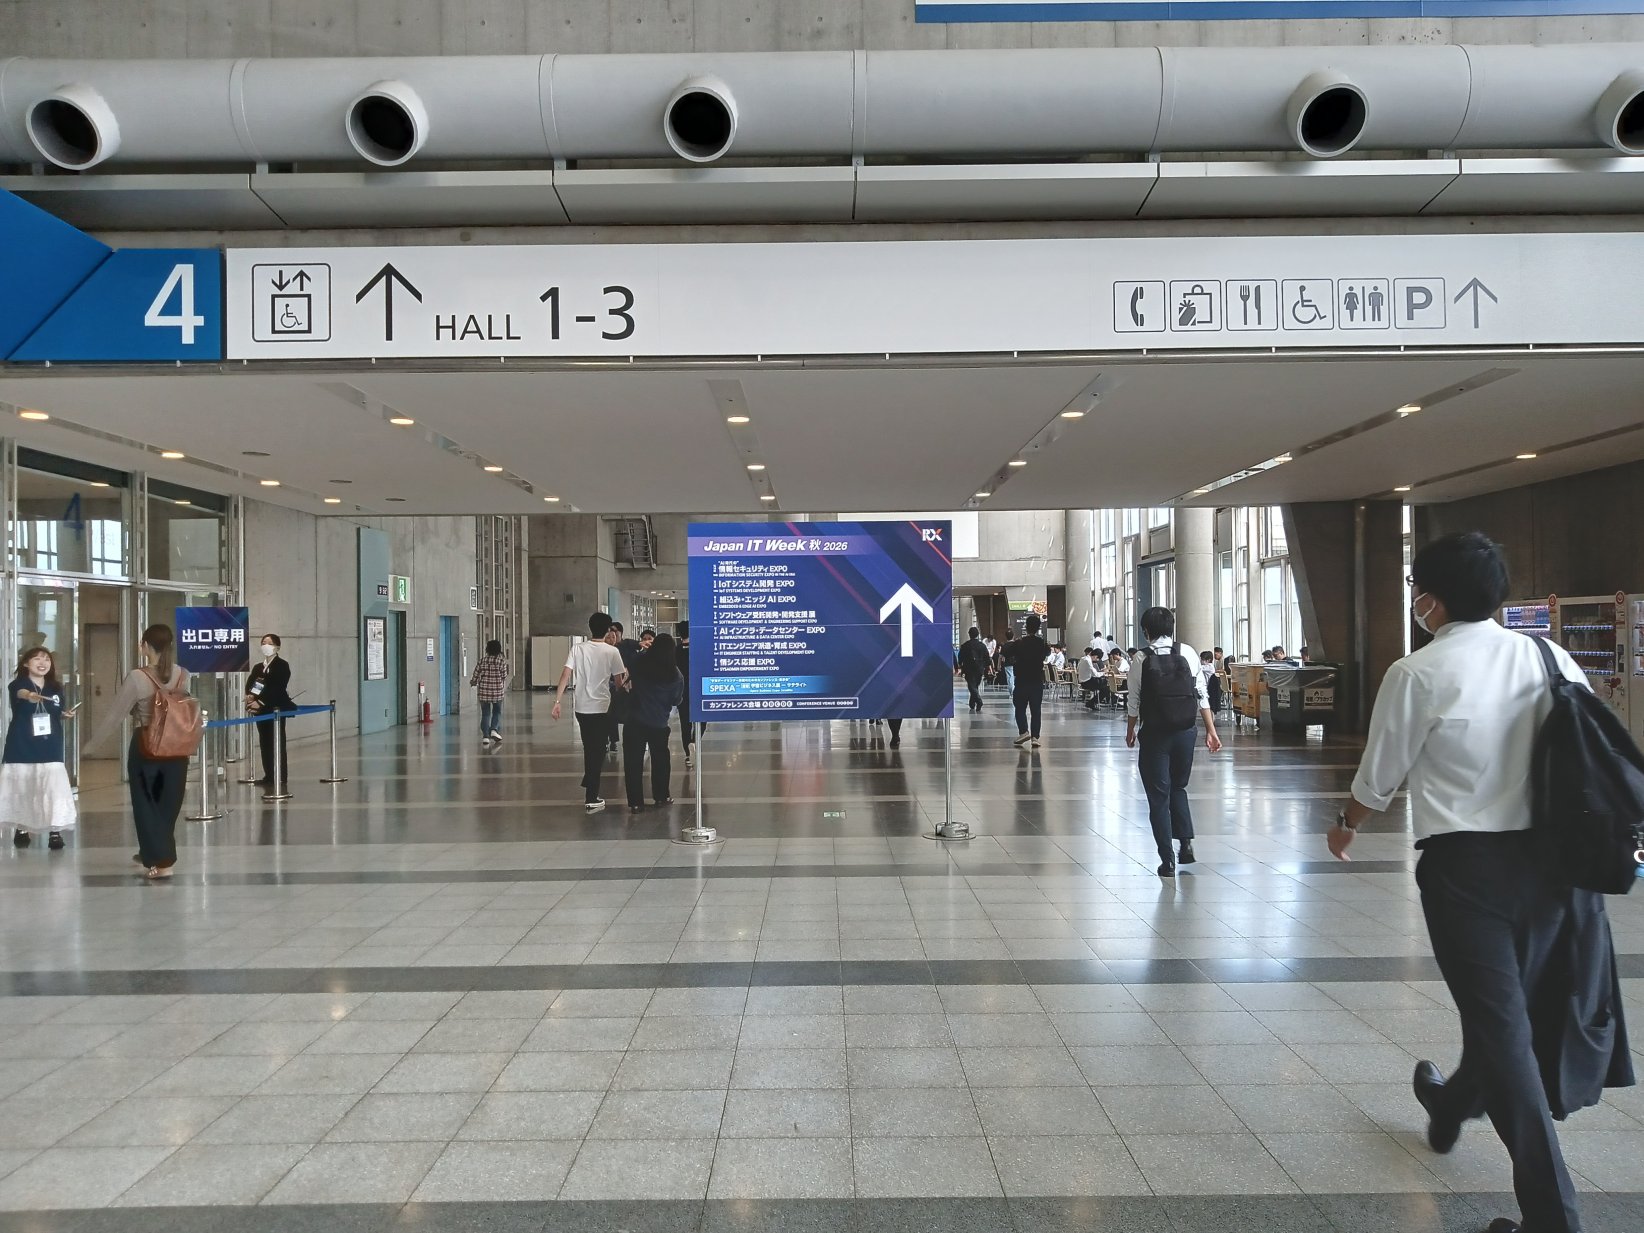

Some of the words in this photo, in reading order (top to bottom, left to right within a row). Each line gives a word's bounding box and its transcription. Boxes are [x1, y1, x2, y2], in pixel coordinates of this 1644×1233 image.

[144, 263, 205, 345] 4
[435, 315, 521, 342] HALL
[540, 286, 636, 341] 1-3
[1407, 286, 1433, 321] P
[704, 540, 744, 553] Japan
[747, 540, 763, 552] IT
[765, 539, 807, 551] Week
[809, 539, 822, 551] 秋
[823, 542, 848, 551] 2026
[922, 528, 943, 542] RX
[182, 628, 245, 643] 出口専用
